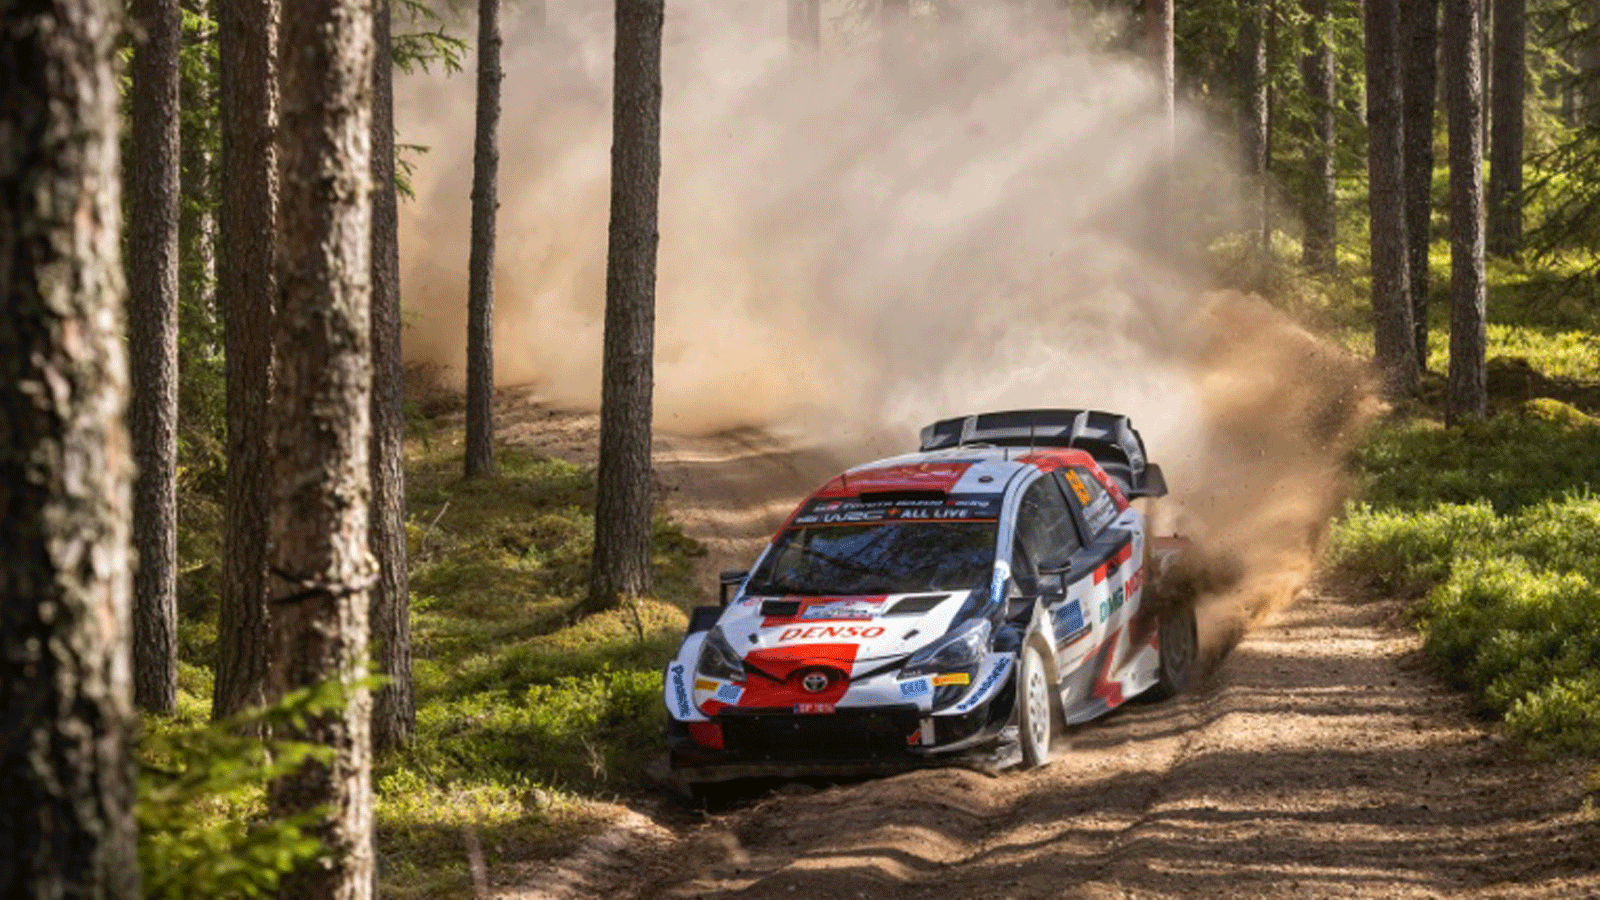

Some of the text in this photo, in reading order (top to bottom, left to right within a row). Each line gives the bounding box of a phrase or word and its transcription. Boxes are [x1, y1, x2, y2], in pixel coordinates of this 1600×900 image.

[823, 510, 884, 522] WRC
[900, 508, 929, 519] ALL
[933, 508, 969, 519] LIVE
[779, 626, 886, 642] DENSO
[670, 663, 692, 719] Panasonic
[957, 656, 1012, 711] Panasonic
